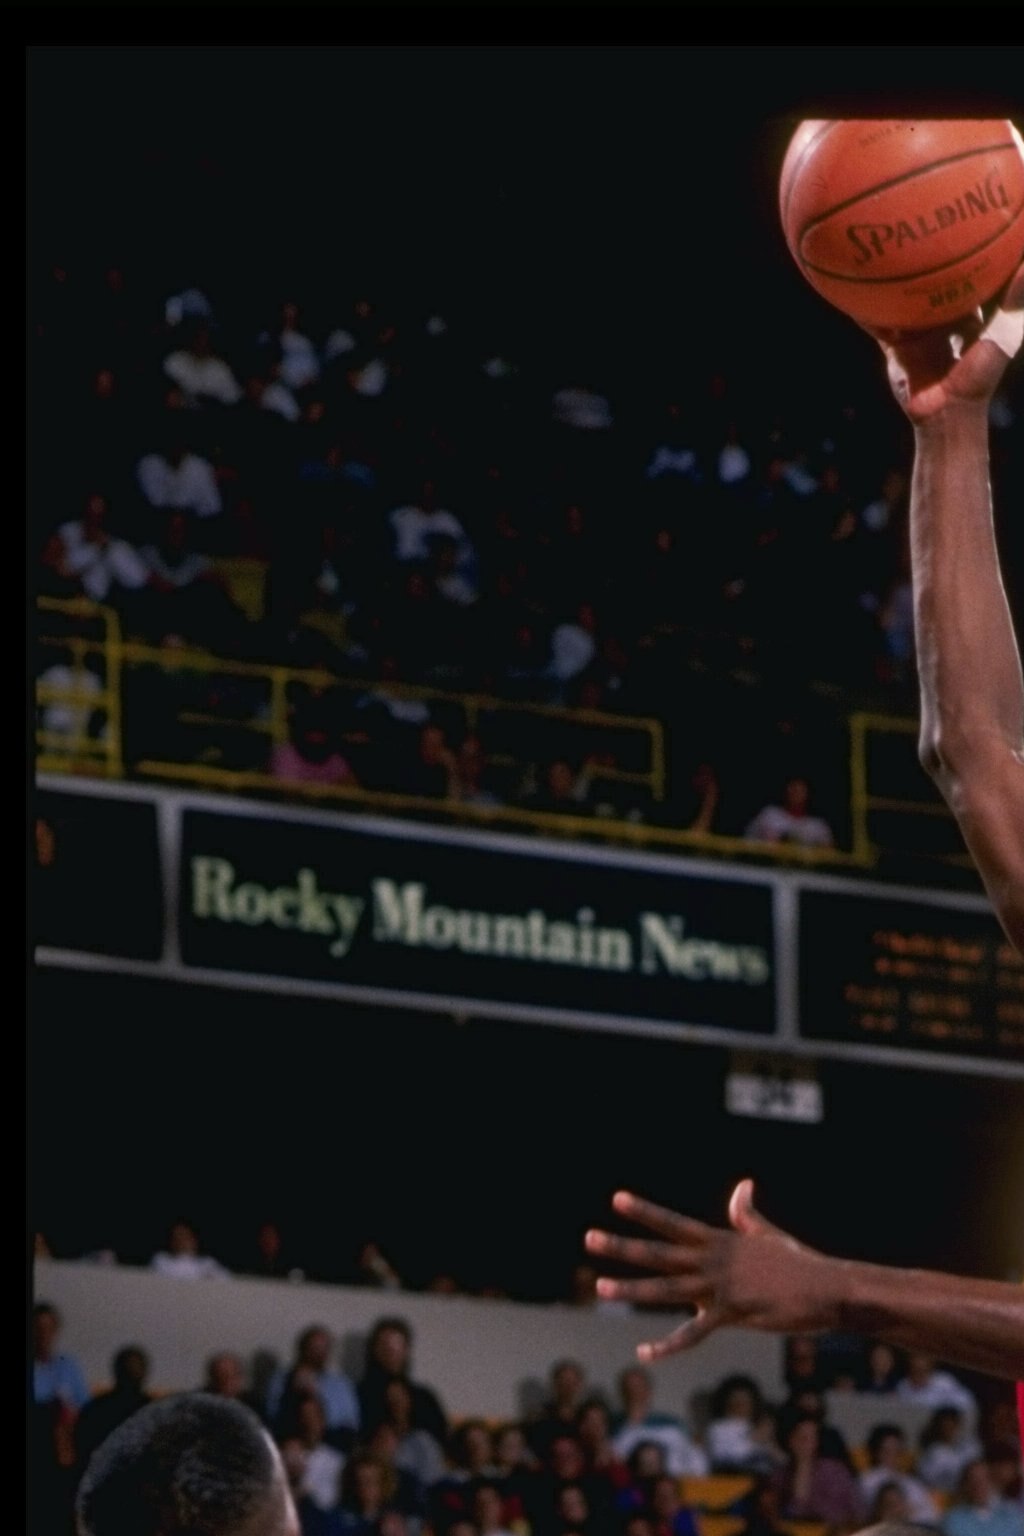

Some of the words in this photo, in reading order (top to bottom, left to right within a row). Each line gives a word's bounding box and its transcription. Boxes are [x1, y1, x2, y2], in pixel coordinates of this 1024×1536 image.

[845, 166, 1009, 266] SPALDING
[191, 855, 365, 958] Rocky
[372, 878, 632, 971] Mountain
[640, 914, 768, 985] News
